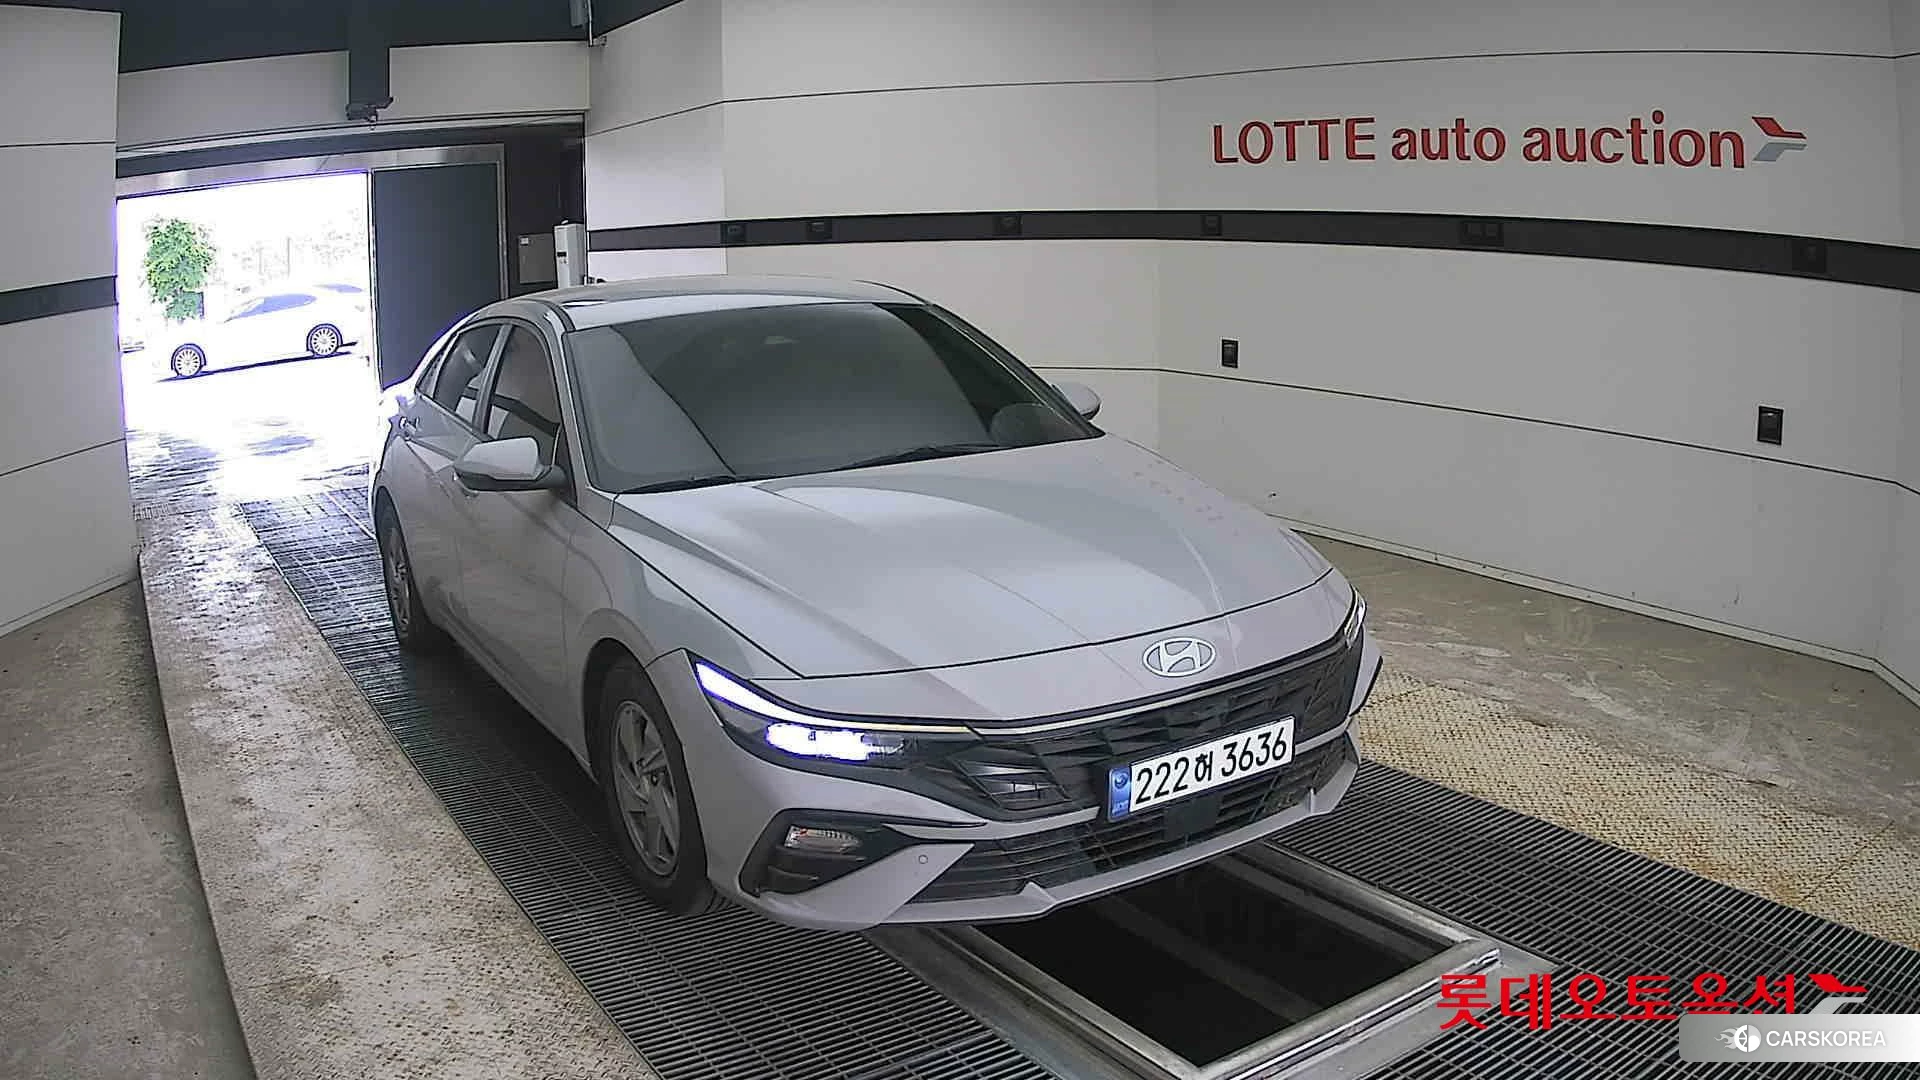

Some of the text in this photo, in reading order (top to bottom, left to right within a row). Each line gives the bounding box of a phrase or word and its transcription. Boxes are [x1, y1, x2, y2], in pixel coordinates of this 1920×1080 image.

[1212, 110, 1746, 169] LOTTE auto auction
[1135, 727, 1287, 805] 222허 3636
